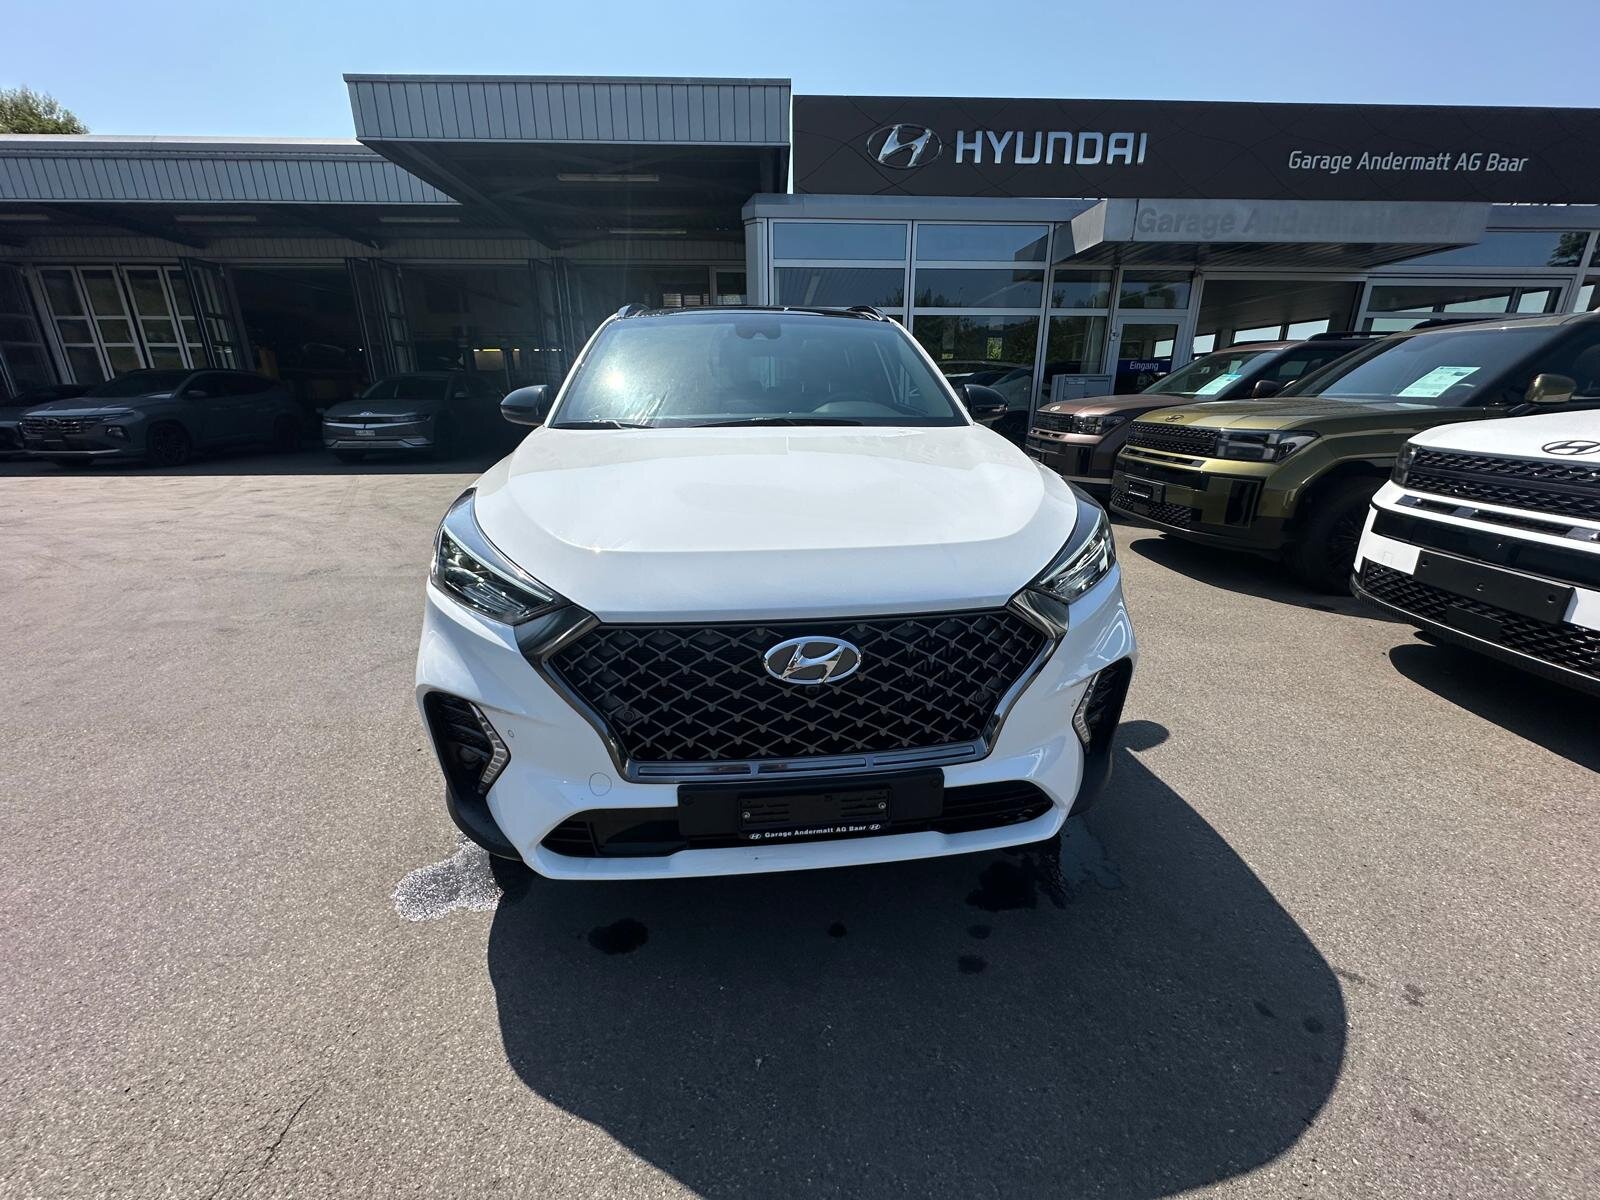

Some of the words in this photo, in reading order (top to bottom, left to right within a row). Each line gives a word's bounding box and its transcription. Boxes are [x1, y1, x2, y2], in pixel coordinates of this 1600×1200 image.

[955, 130, 1148, 165] HYUNDAI
[1288, 150, 1352, 174] Garage
[1356, 152, 1452, 171] Andermatt
[1453, 153, 1483, 171] AG
[1485, 153, 1529, 172] Baar
[1137, 207, 1236, 239] Garage
[1129, 361, 1159, 371] Eingang
[764, 831, 792, 839] Garage
[794, 827, 834, 836] Andermatt
